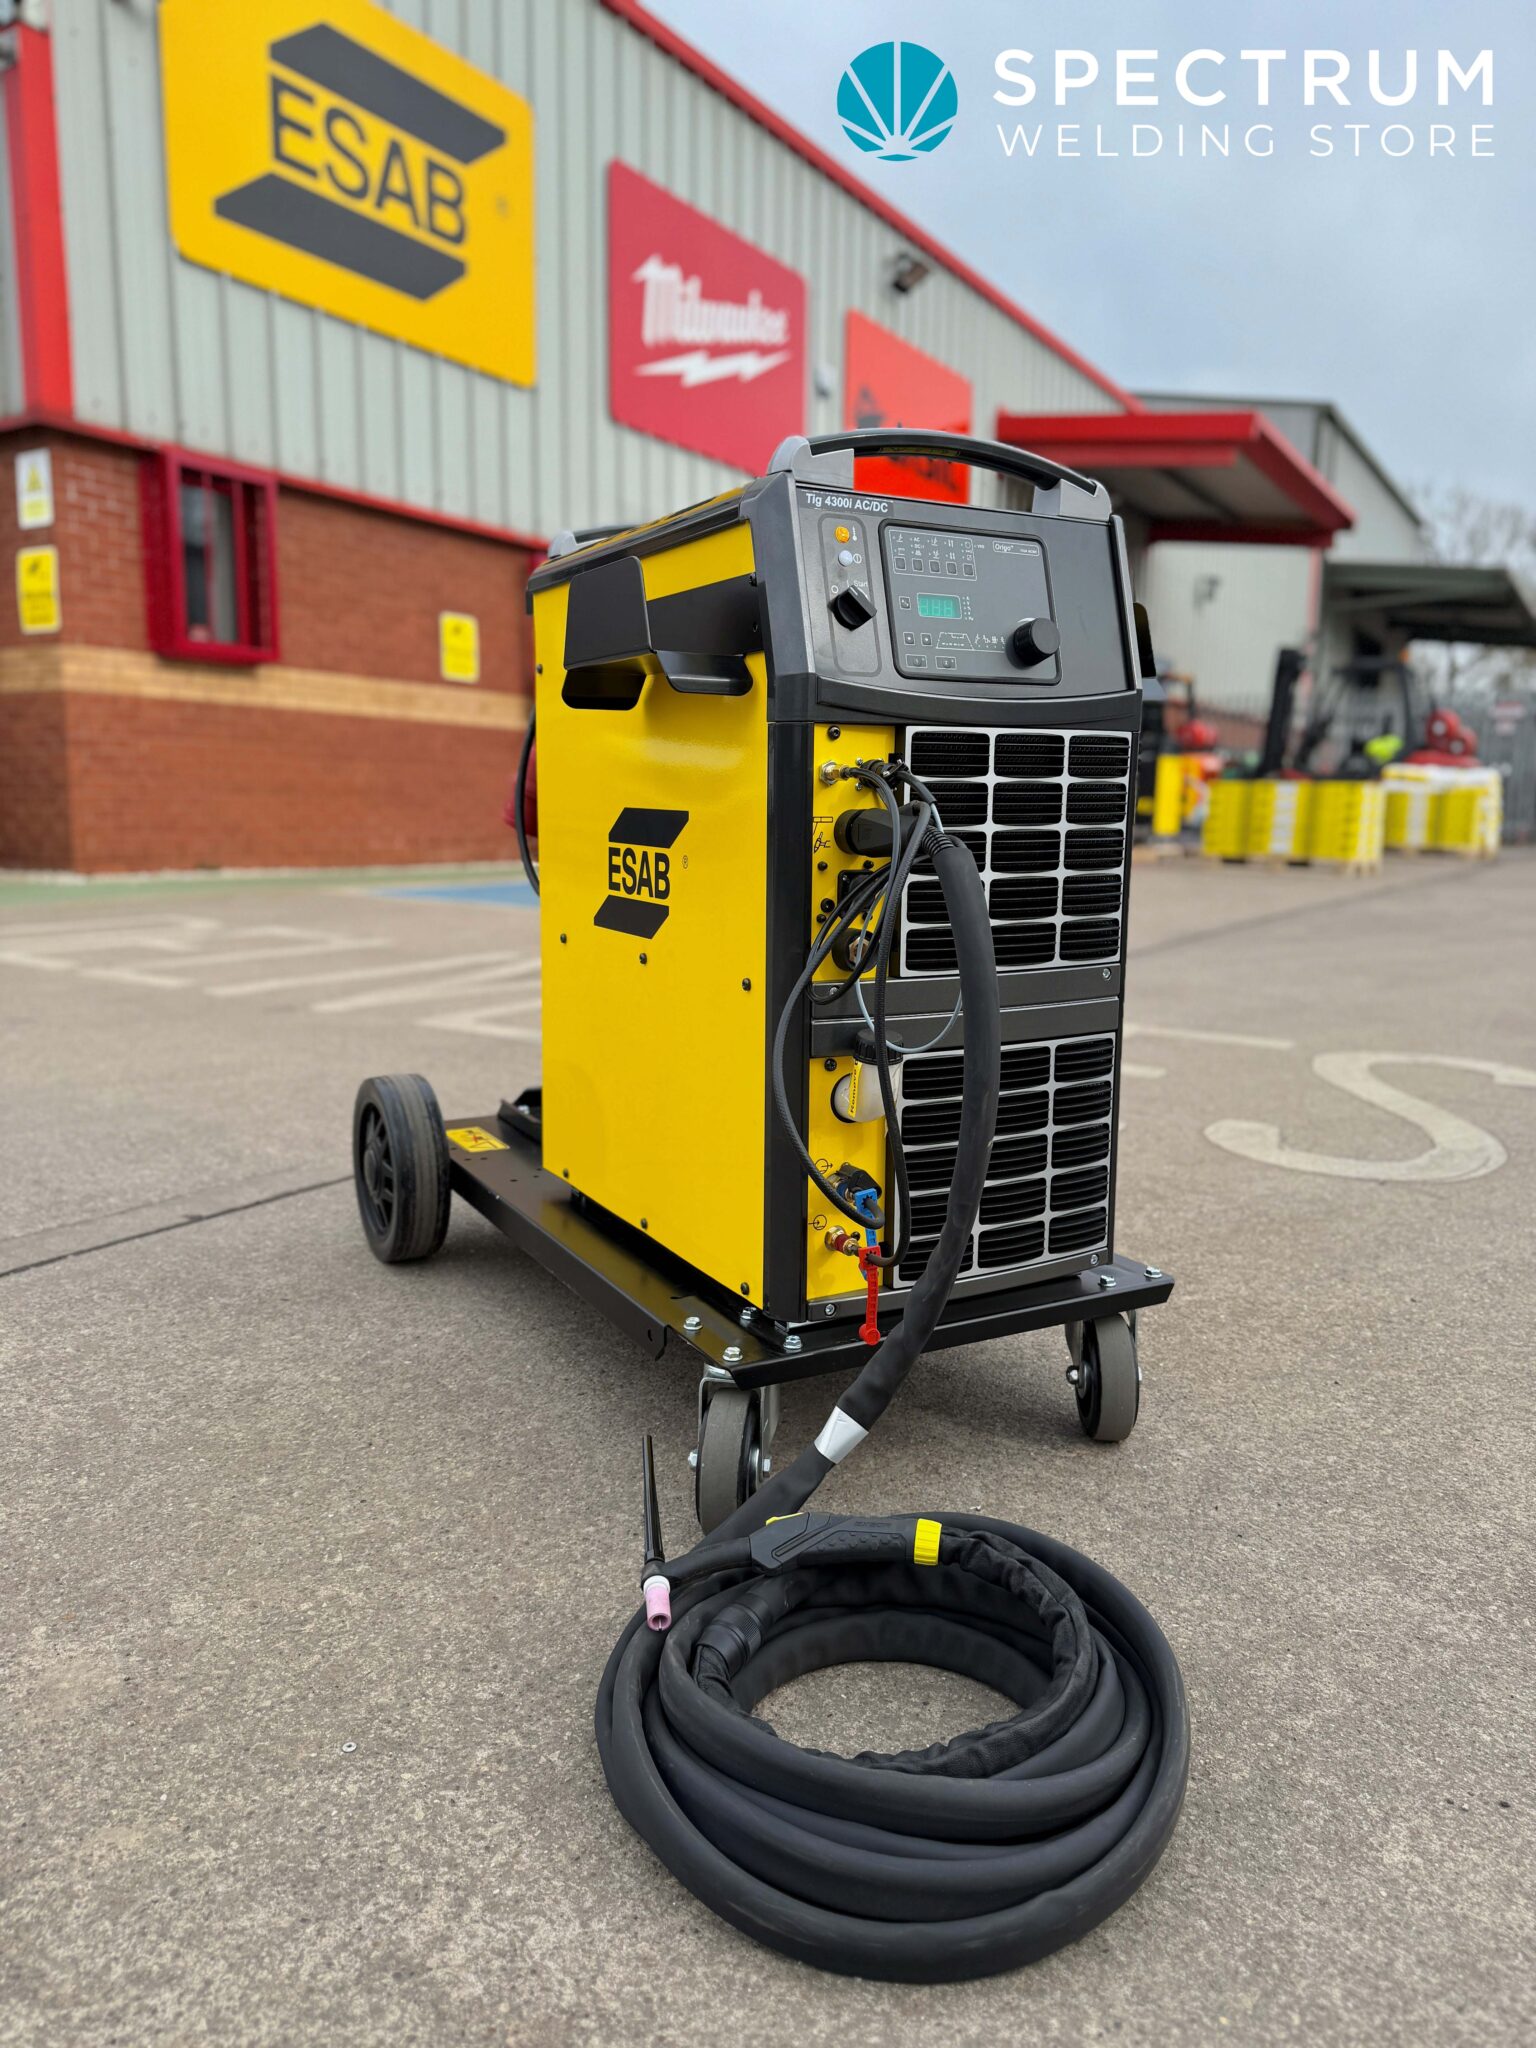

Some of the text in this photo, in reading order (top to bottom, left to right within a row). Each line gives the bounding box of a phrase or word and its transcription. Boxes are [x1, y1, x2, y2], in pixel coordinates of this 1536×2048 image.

[270, 74, 467, 246] ESAB
[806, 493, 889, 513] Tig 4300i AC/DC
[608, 846, 671, 900] ESAB
